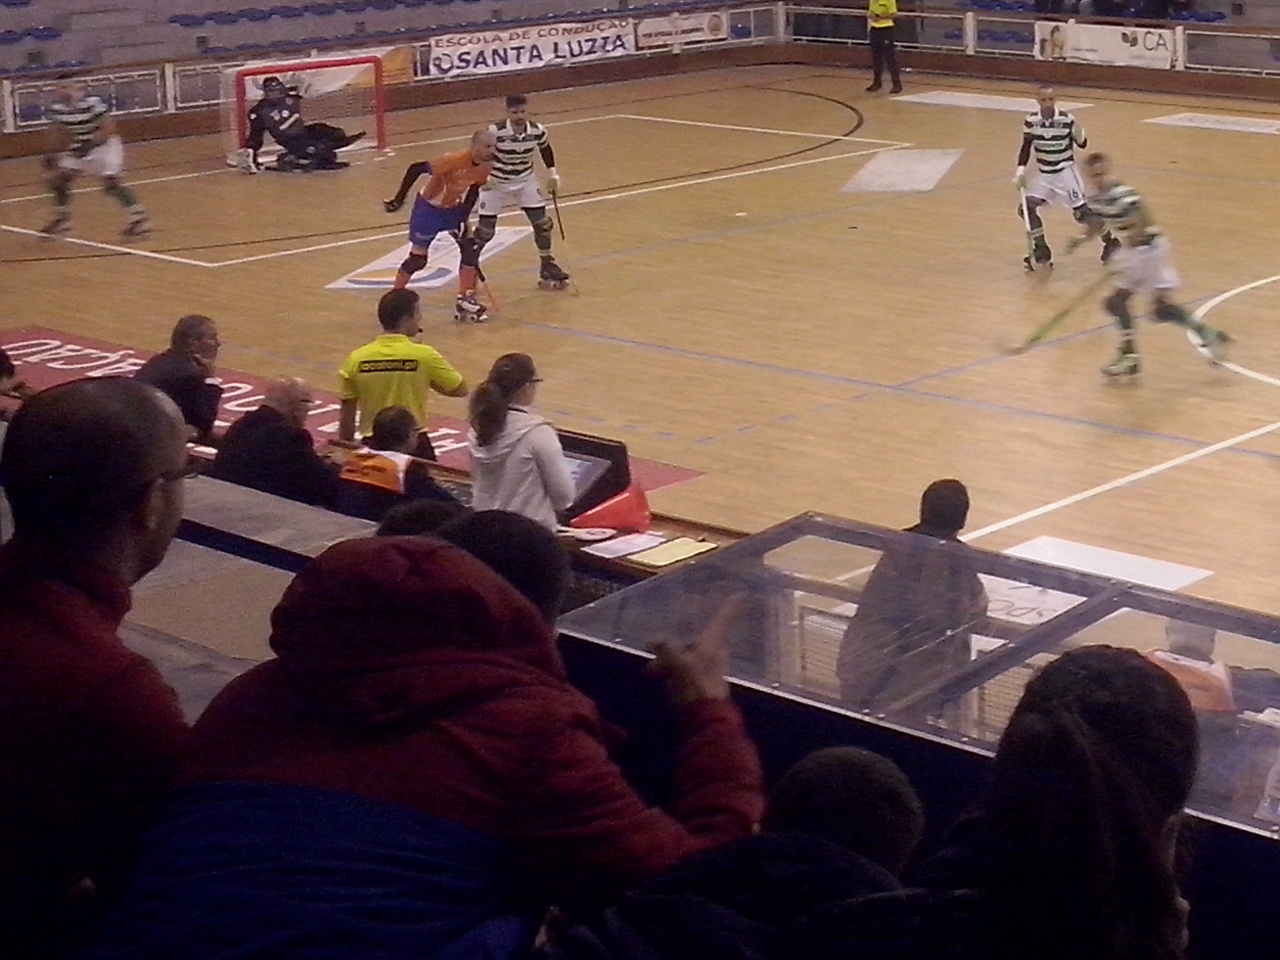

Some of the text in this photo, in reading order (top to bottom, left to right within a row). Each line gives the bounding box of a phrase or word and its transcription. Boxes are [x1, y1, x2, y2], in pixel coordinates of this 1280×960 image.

[435, 35, 503, 48] ESCOLA
[509, 27, 531, 41] DE
[1143, 30, 1169, 52] CA
[456, 34, 627, 70] SANTA LUZIA
